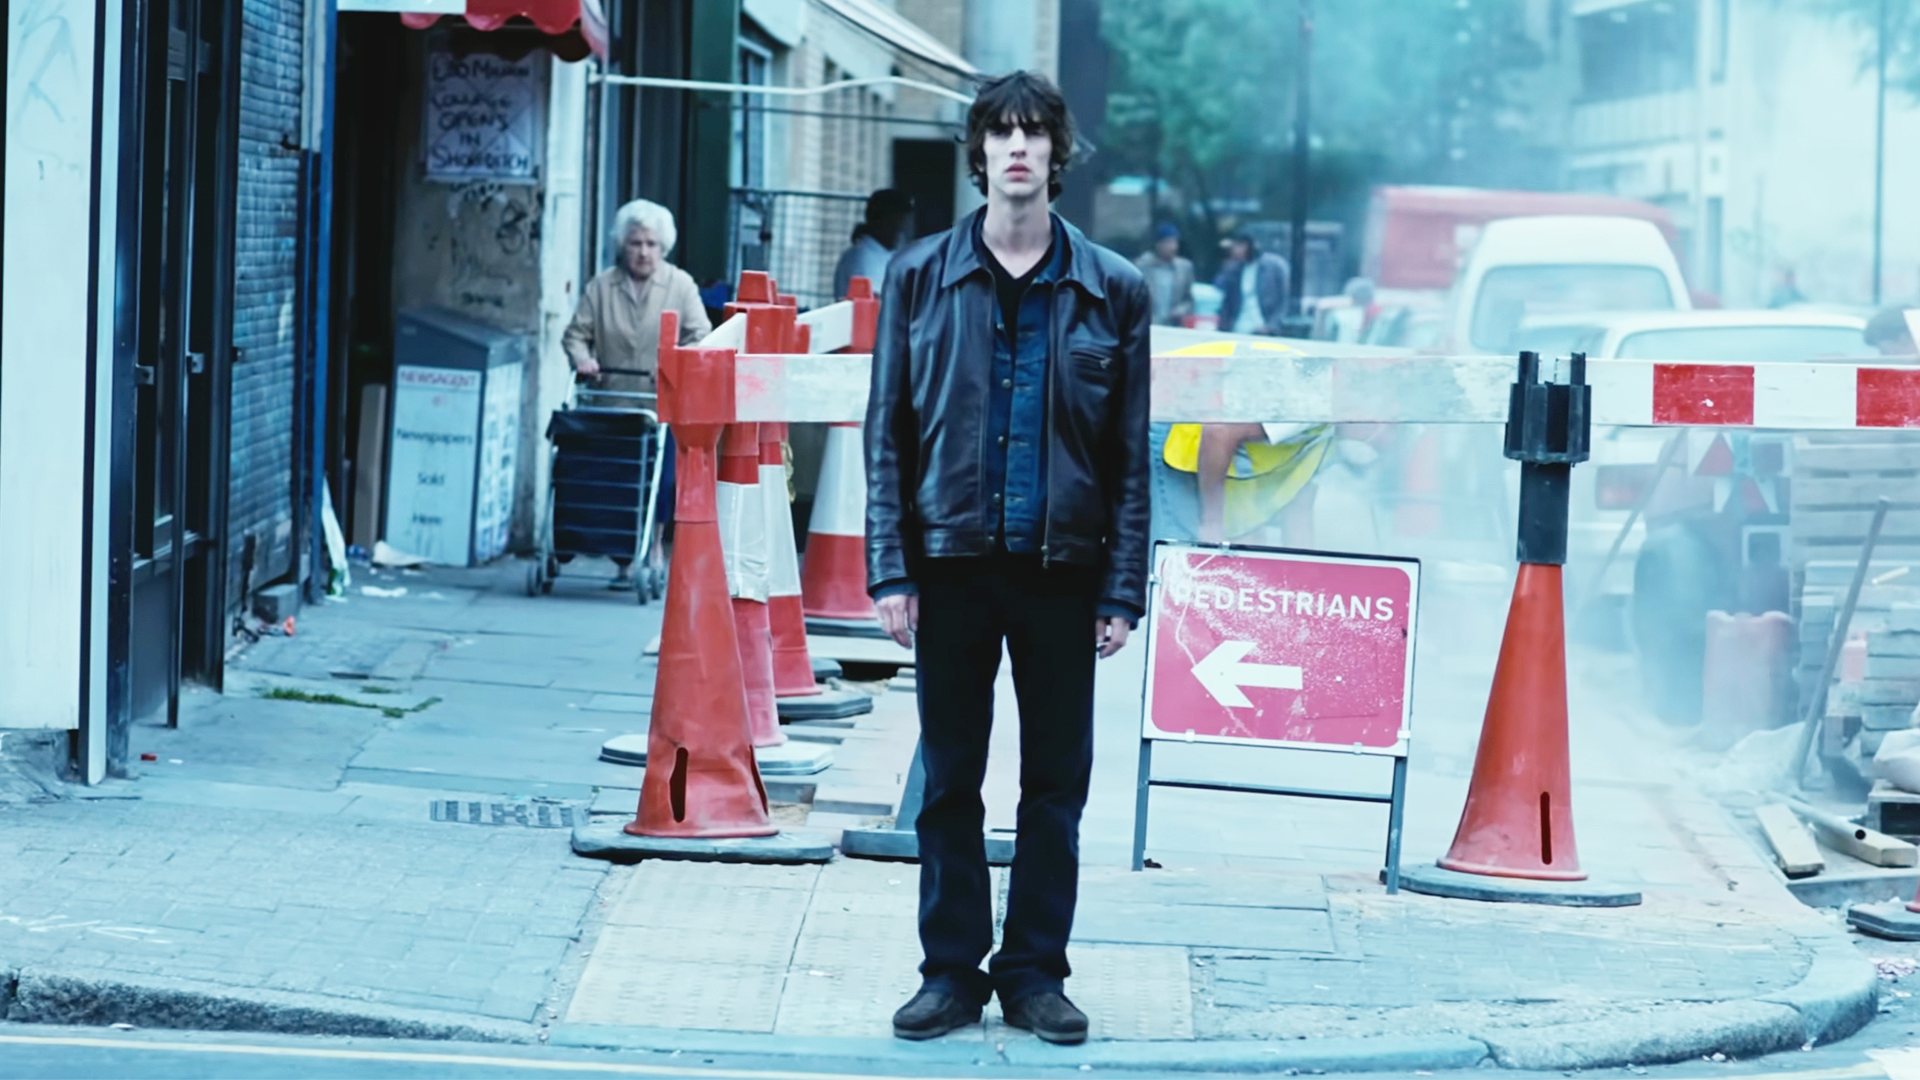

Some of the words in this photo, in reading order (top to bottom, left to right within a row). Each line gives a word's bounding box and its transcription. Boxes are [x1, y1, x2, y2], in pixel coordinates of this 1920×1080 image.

[459, 132, 481, 146] IN
[401, 371, 477, 388] NEWSAGENT
[396, 428, 473, 447] Newspapers
[417, 472, 445, 486] Sold
